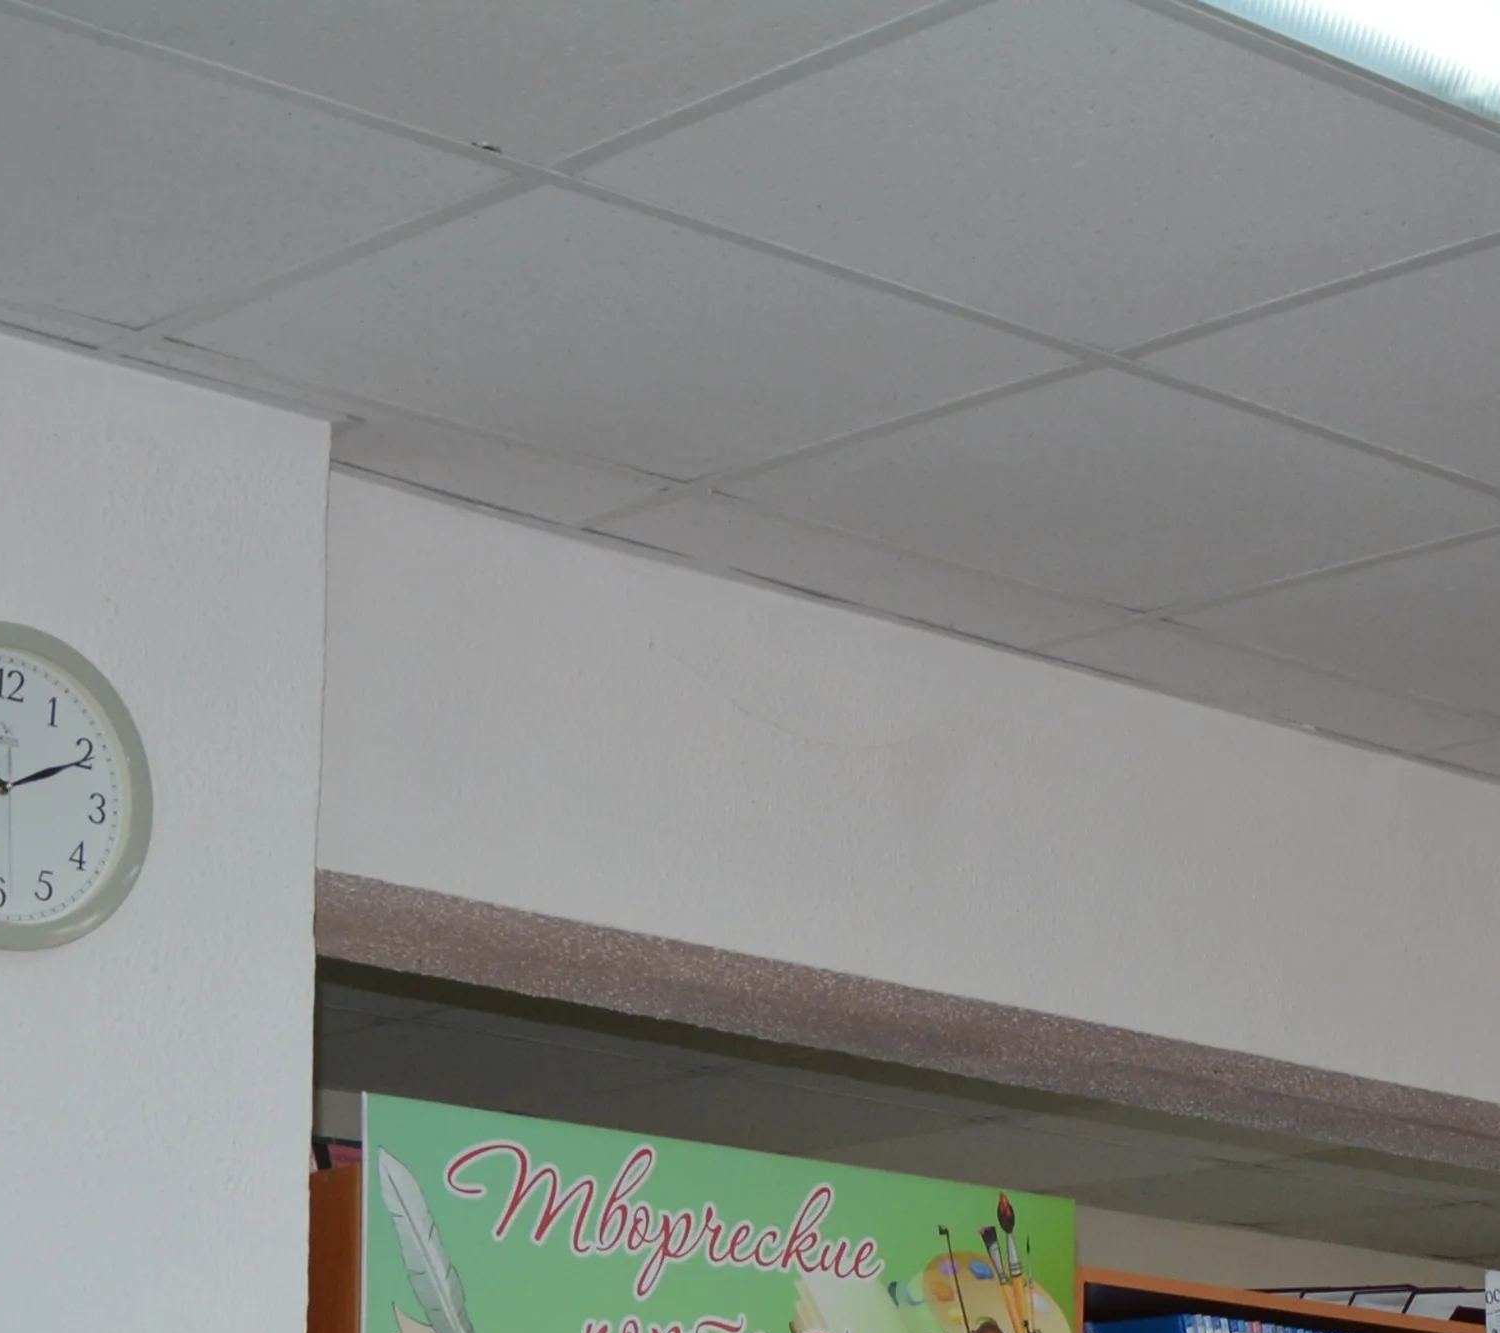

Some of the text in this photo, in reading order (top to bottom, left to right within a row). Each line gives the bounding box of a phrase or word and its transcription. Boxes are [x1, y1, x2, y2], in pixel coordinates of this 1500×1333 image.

[46, 697, 59, 728] 1
[75, 737, 94, 770] 2
[88, 793, 107, 824] 3
[69, 841, 87, 871] 4
[34, 870, 53, 902] 5
[447, 1142, 882, 1297] Творческие
